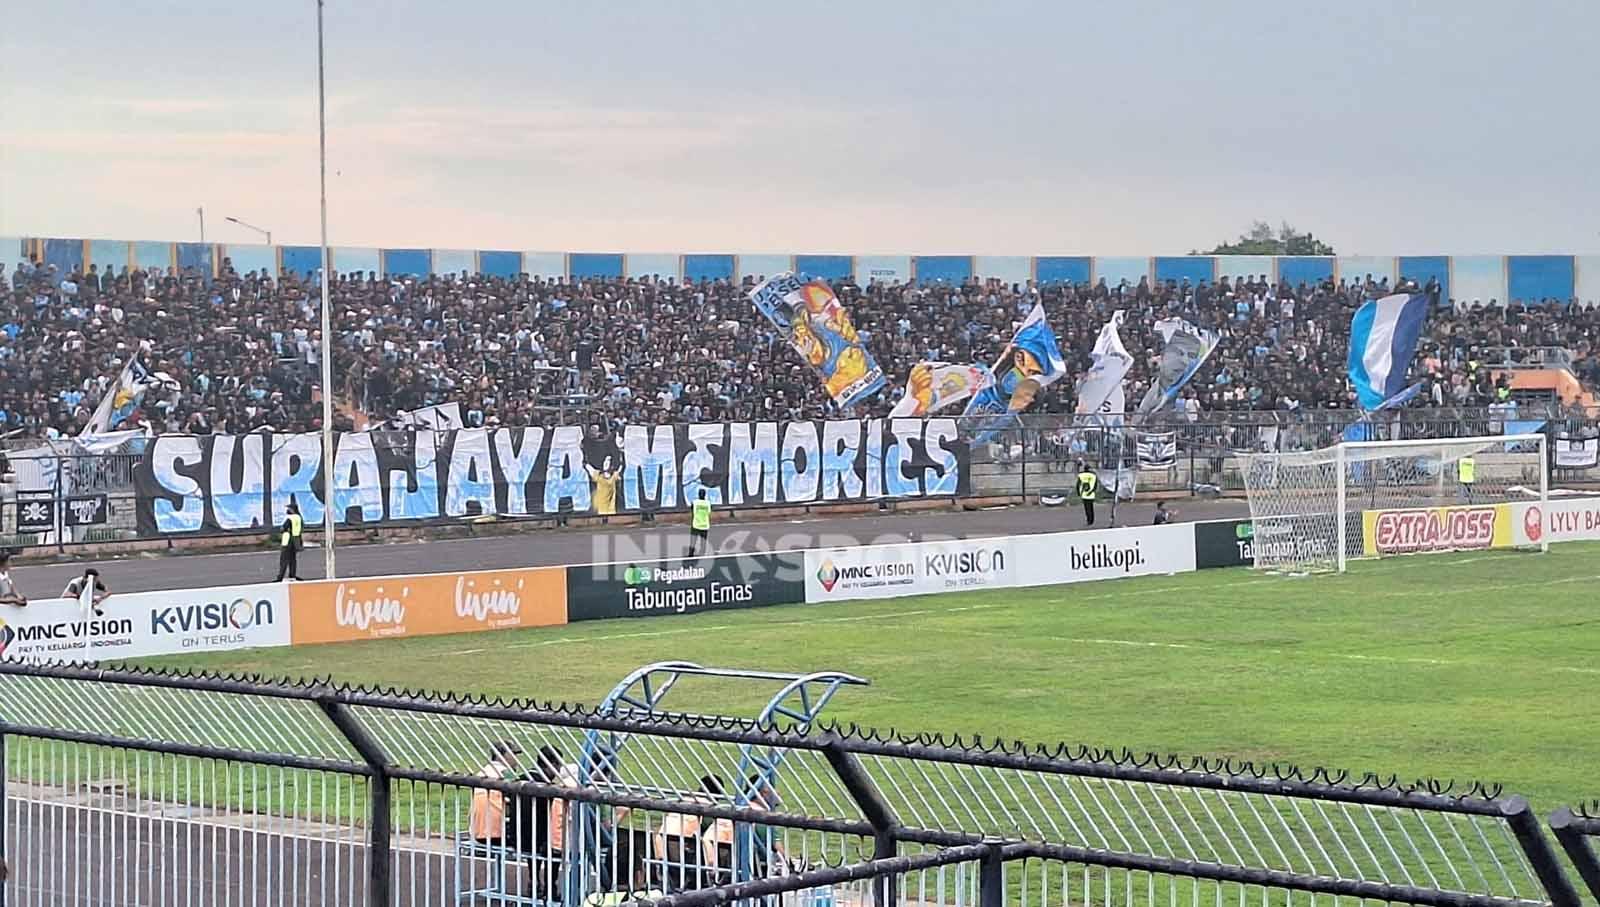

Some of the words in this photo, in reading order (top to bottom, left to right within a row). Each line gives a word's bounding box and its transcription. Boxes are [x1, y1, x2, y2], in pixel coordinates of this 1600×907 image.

[152, 425, 592, 534] SURAJAYA
[623, 418, 959, 509] MEMORIES
[1550, 512, 1580, 532] LYLY
[1071, 541, 1145, 572] belikopi.
[654, 567, 705, 584] Pegadaian
[842, 566, 873, 579] MNC
[625, 587, 706, 612] Tabungan
[711, 582, 753, 604] Emas
[18, 623, 67, 641] MNC
[182, 638, 199, 648] ON
[203, 634, 245, 645] TERUS
